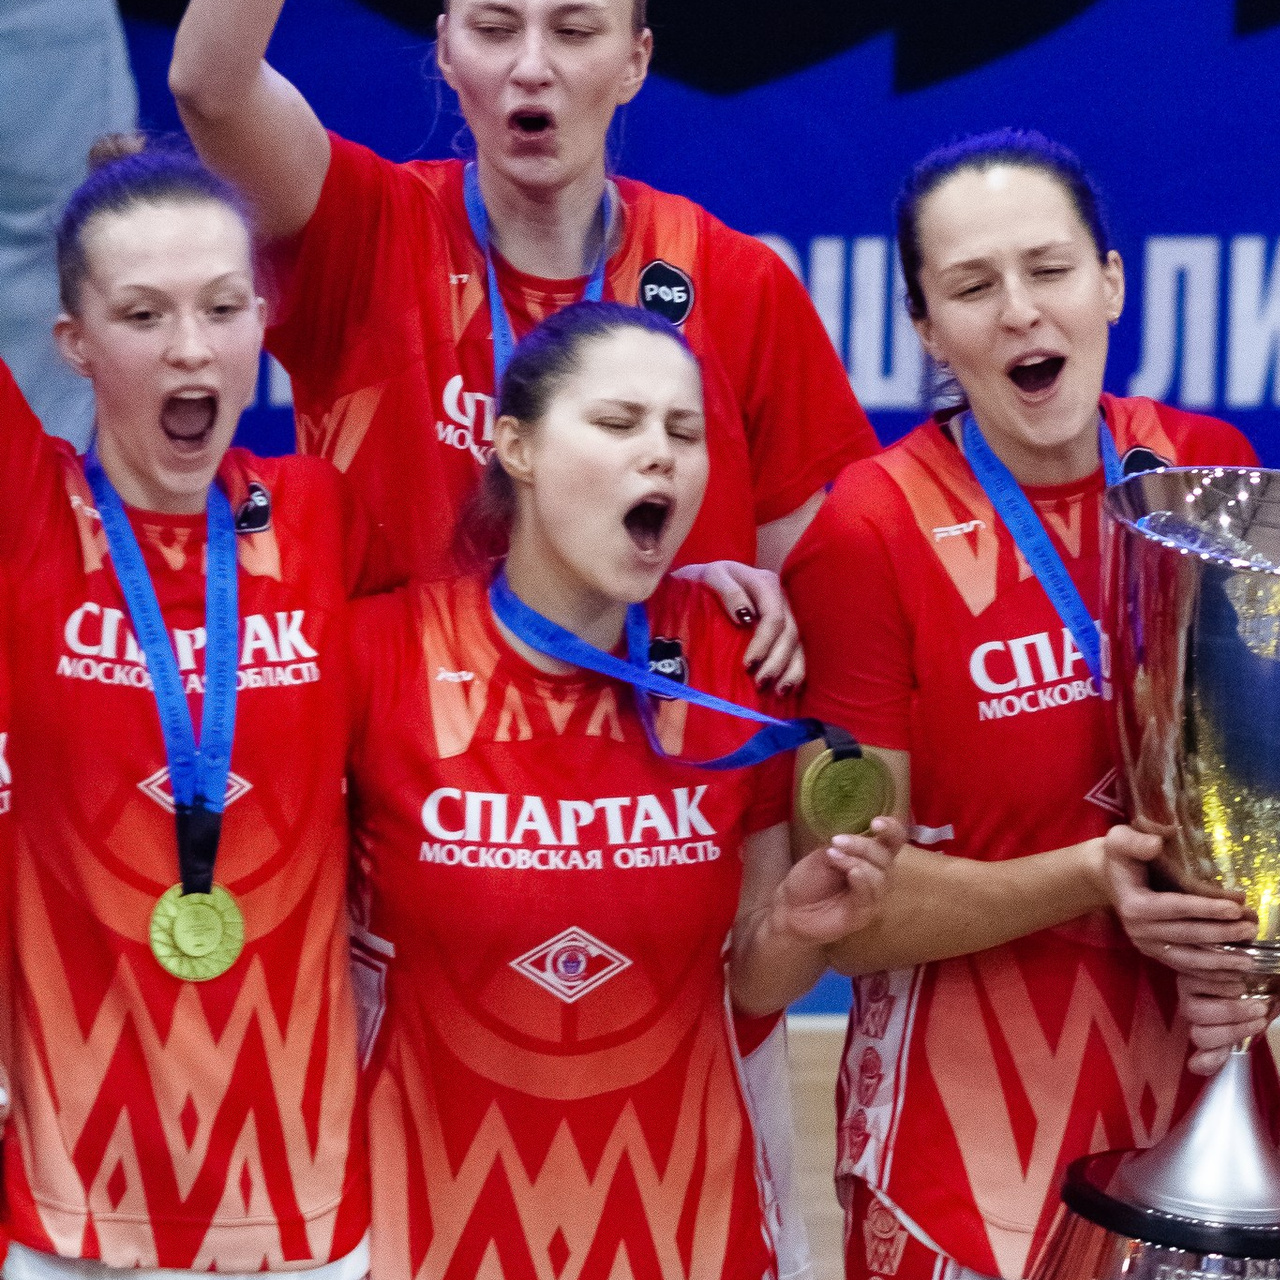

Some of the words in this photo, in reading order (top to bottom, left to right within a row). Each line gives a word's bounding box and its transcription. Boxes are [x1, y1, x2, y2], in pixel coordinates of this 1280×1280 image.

[64, 601, 319, 671] СПРАК
[421, 785, 717, 846] СПАРТАК
[419, 841, 602, 870] МОСКОВСКАЯ
[613, 840, 721, 869] ОБЛАСТЬ
